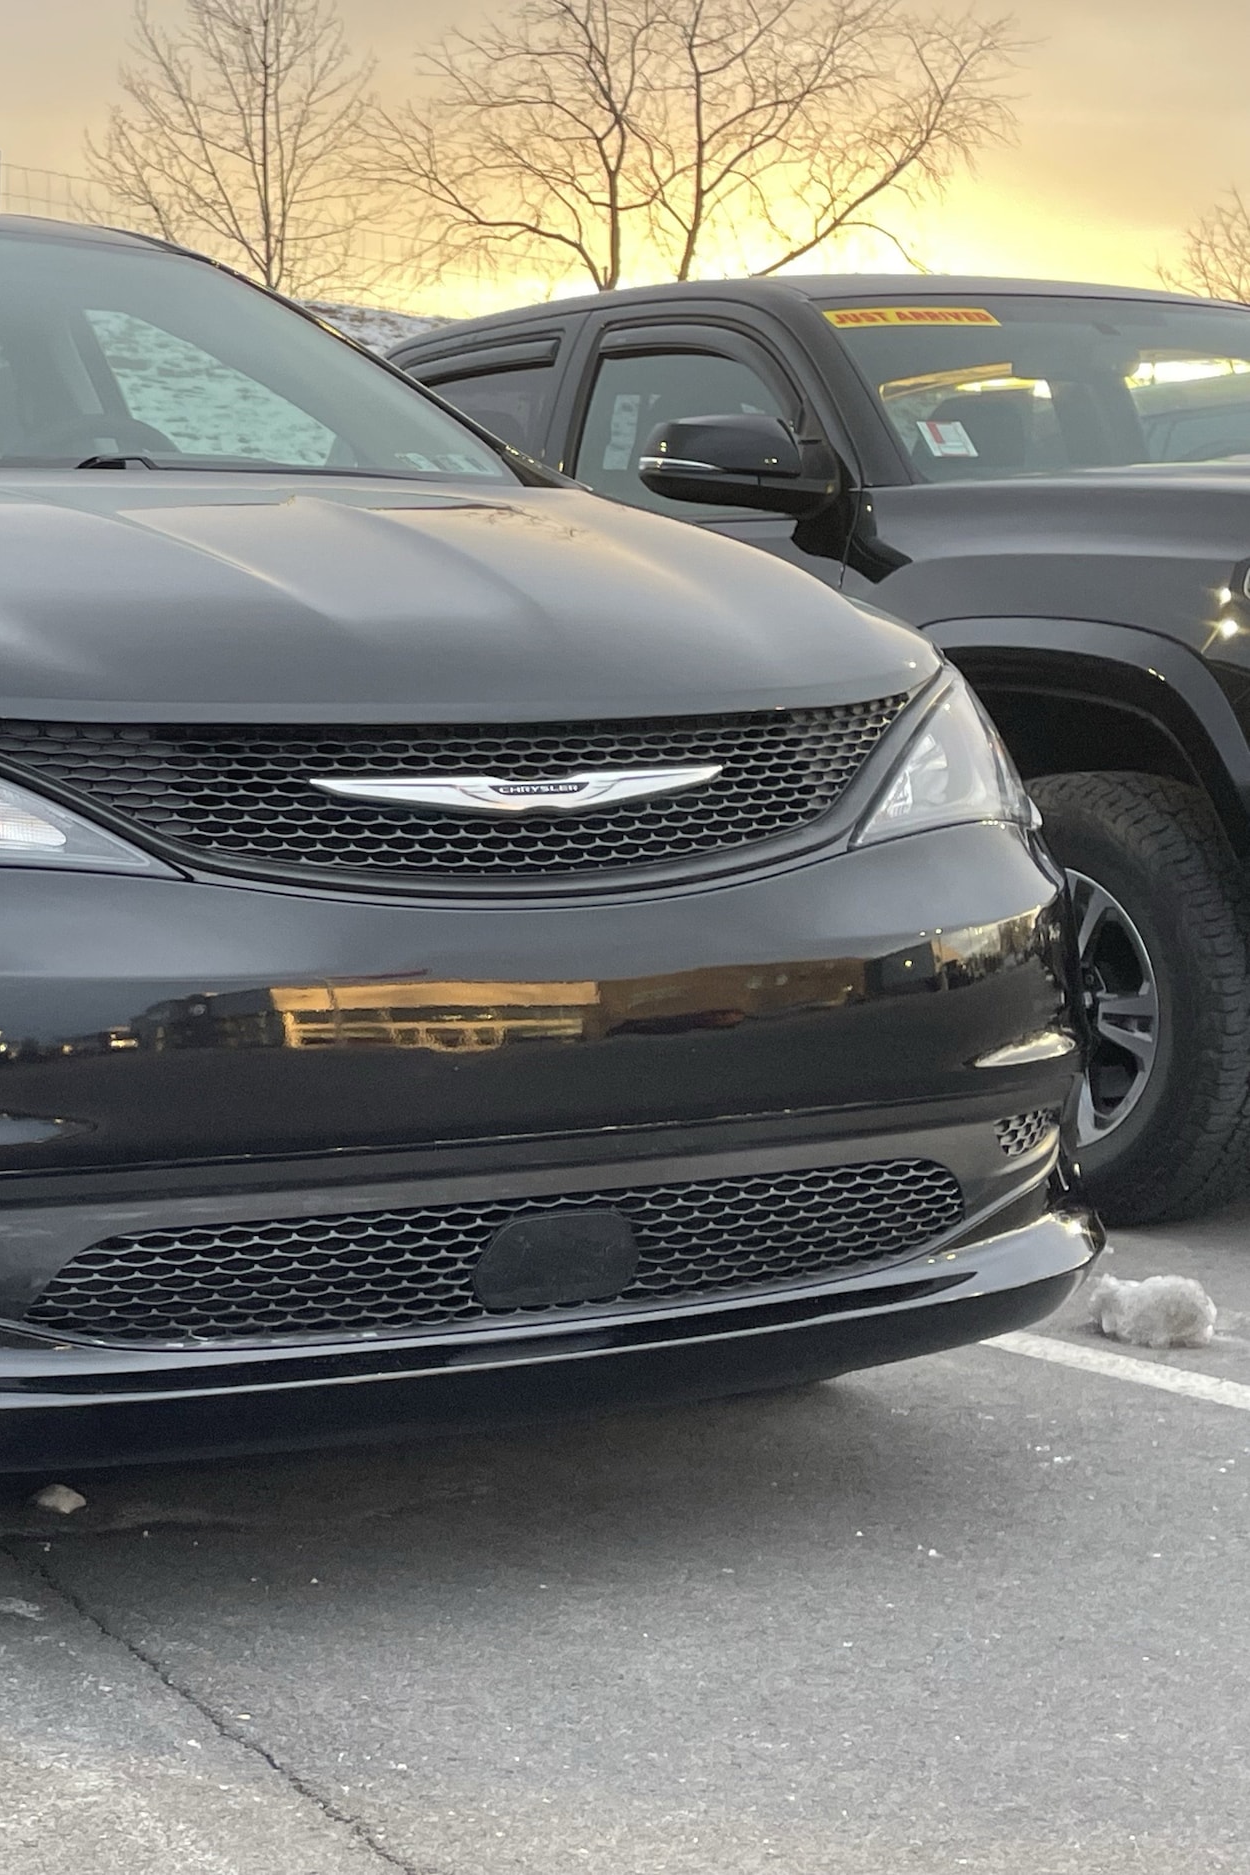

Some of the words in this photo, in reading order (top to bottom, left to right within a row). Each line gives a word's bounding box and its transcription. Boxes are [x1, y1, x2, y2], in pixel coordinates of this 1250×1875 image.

[834, 311, 888, 325] JUST
[895, 310, 993, 323] ARRIVED
[498, 784, 578, 794] CHRYSLER
